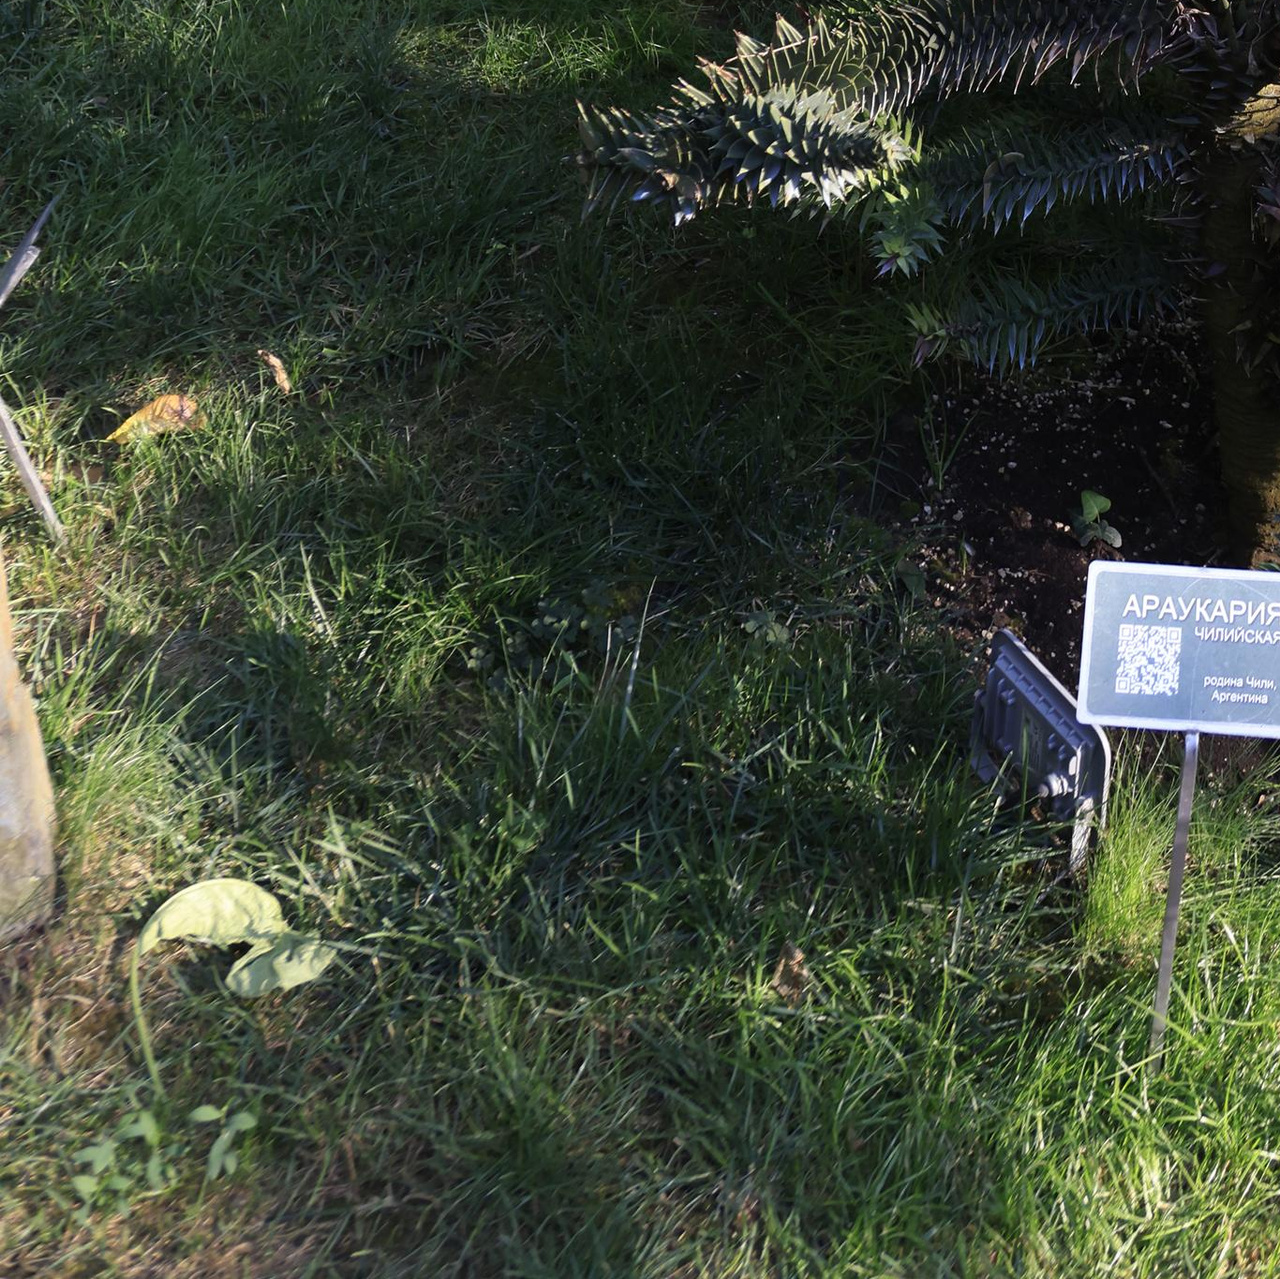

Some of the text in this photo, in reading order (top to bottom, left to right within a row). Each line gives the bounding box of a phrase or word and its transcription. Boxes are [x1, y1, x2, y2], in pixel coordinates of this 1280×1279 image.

[1203, 675, 1277, 691] родина Чили,
[1211, 691, 1268, 704] Аргентина
